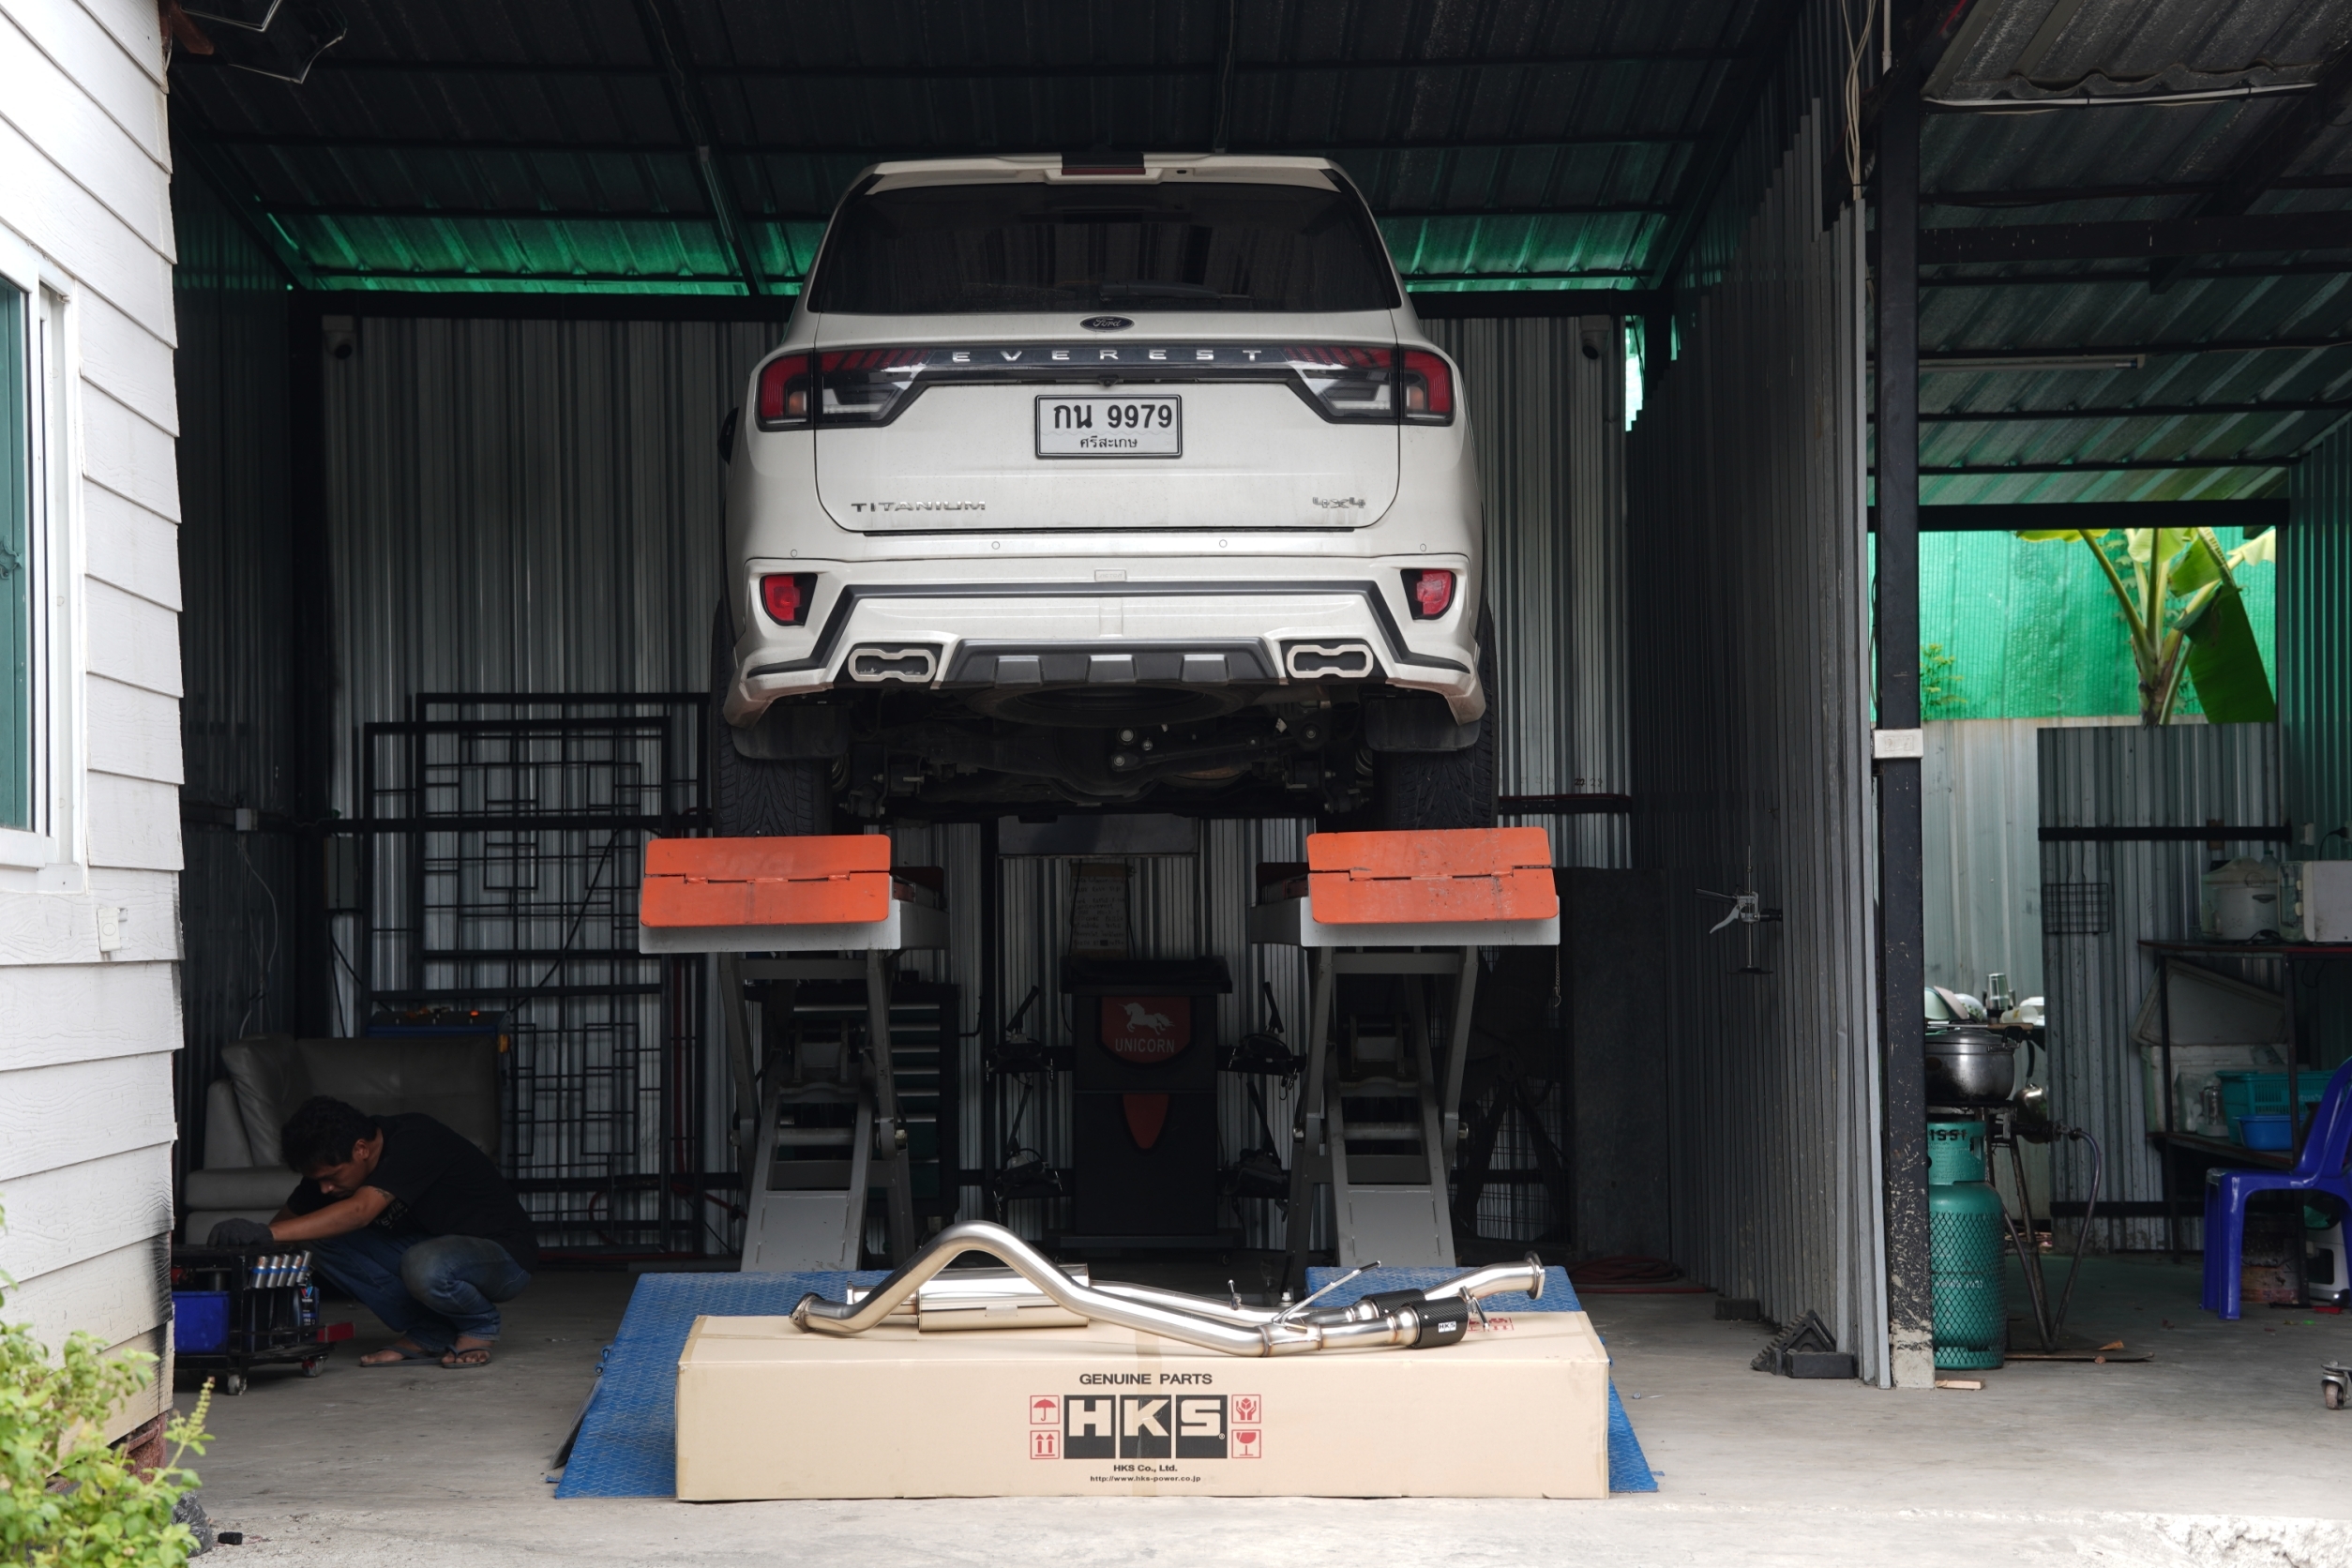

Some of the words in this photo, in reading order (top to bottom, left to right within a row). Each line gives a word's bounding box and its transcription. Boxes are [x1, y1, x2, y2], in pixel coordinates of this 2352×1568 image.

[952, 349, 1262, 363] EVEREST
[1053, 404, 1093, 429] กน
[1108, 404, 1172, 429] 9979
[1079, 435, 1138, 448] ศรีสะเกษ
[851, 501, 986, 512] TITANIUM
[1115, 1037, 1175, 1053] UNICORN
[1439, 1320, 1456, 1331] HKS
[1078, 1373, 1153, 1385] GENUINE
[1159, 1373, 1214, 1385] PARTS
[1067, 1398, 1222, 1439] HKS
[1138, 1465, 1156, 1474] Co.,
[1090, 1475, 1201, 1484] http://www.hks-power.co.jp
